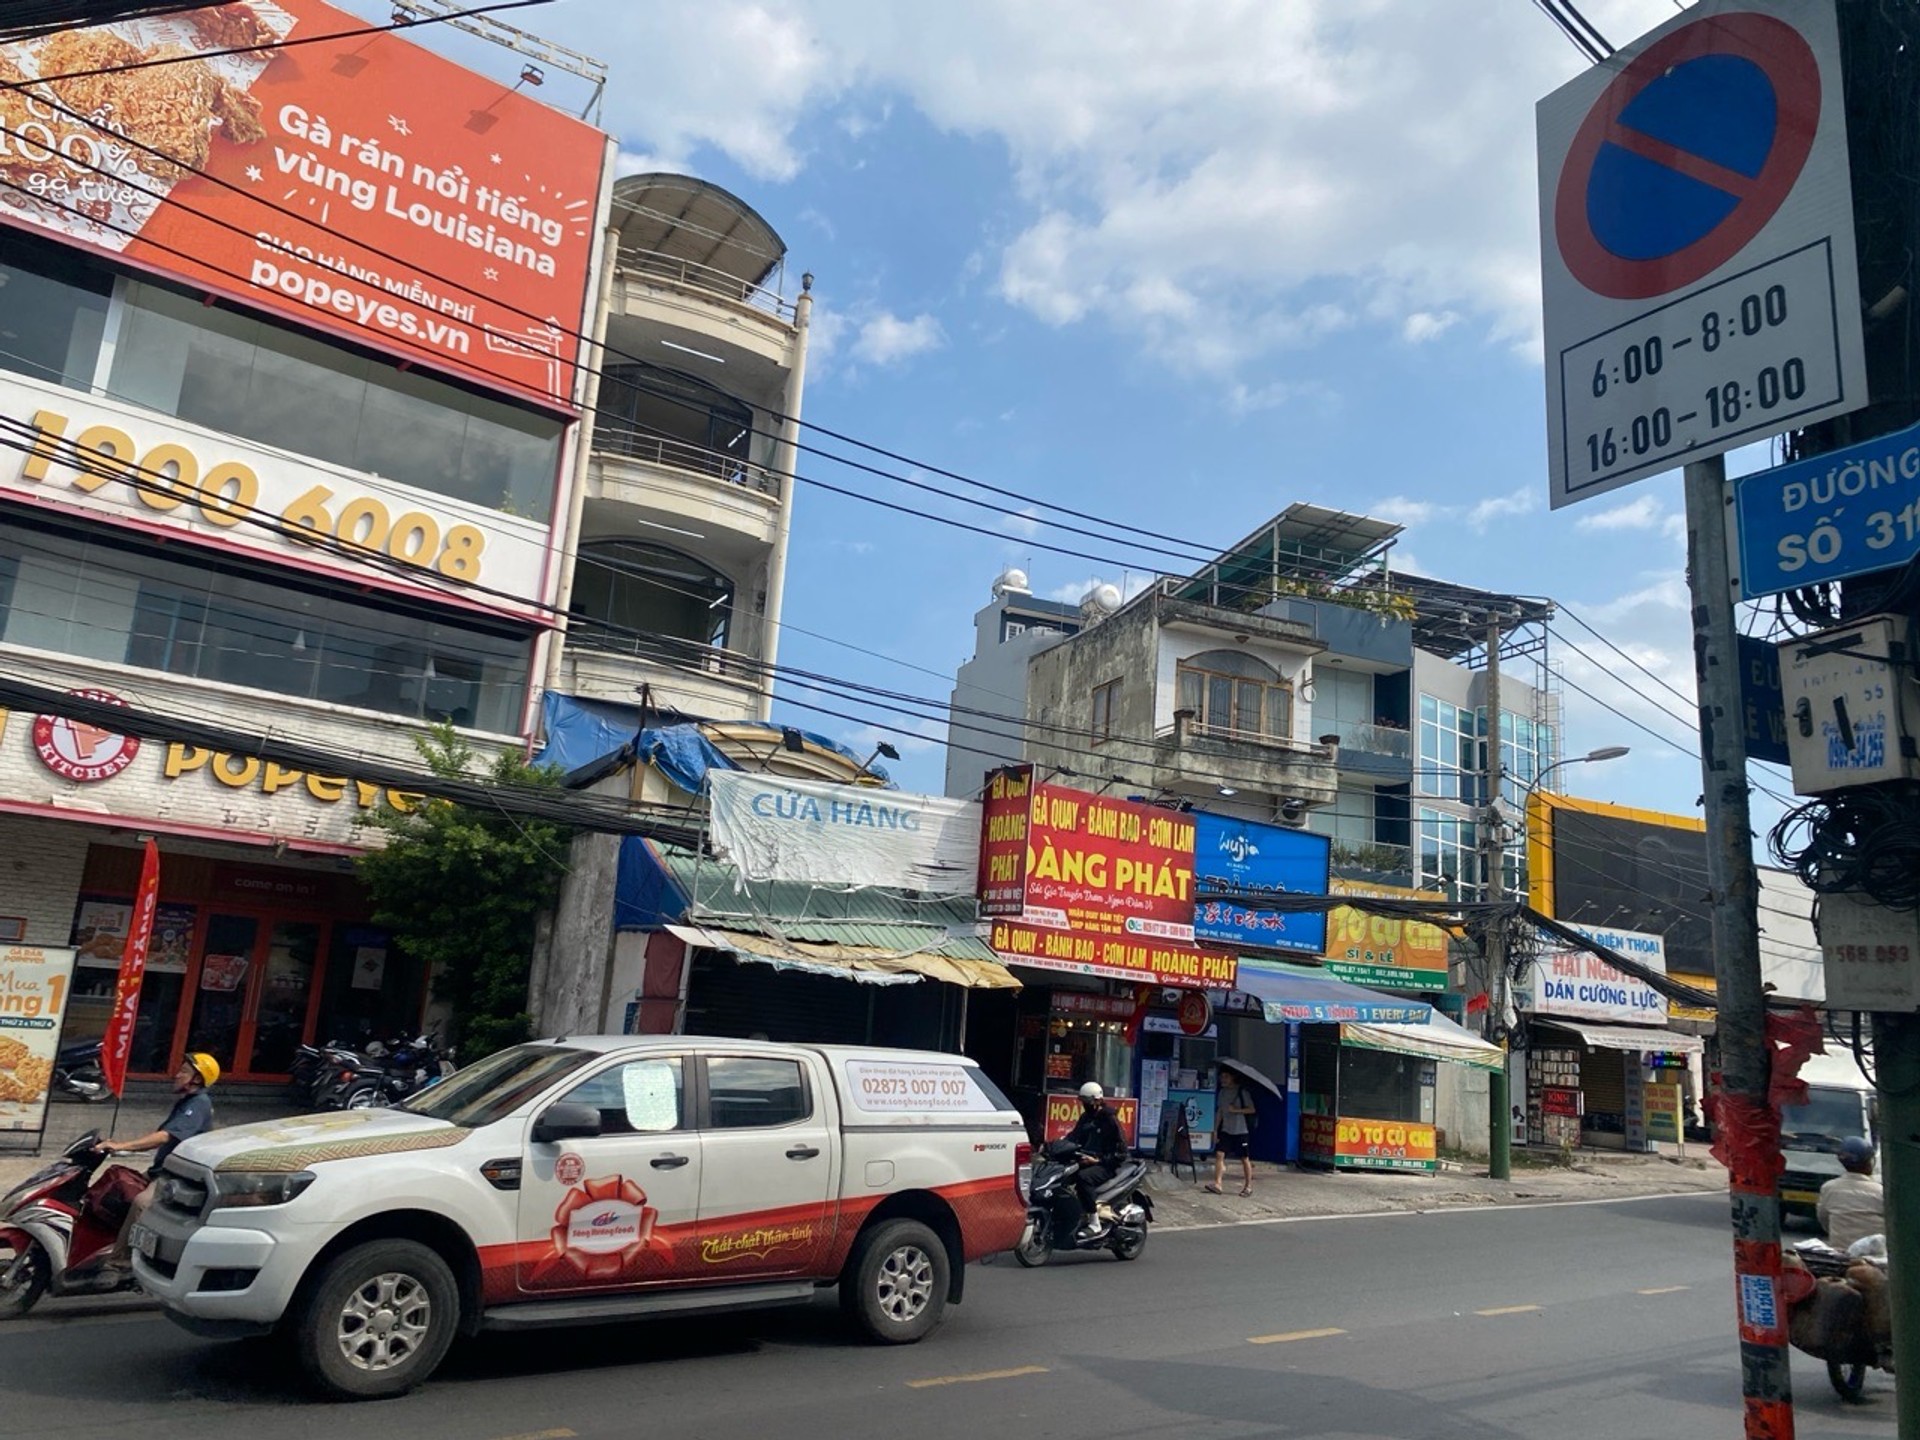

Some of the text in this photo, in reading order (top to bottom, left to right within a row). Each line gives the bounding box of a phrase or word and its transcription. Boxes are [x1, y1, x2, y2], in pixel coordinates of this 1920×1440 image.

[279, 104, 560, 248] Gà rán nổi tiếng
[273, 146, 557, 278] vùng Louisiana
[255, 231, 313, 264] GIAO
[317, 250, 381, 287] HÀNG
[440, 298, 476, 324] PHÍ
[249, 259, 471, 354] popeyes.vn
[22, 410, 486, 581] 1900 6008
[1782, 447, 1920, 513] ĐƯỜNG
[1777, 507, 1844, 572] SỐ
[39, 742, 131, 779] KITCHEN
[751, 788, 821, 822] CỬA
[1033, 790, 1048, 826] GÀ
[1051, 799, 1079, 831] QUAY
[1088, 801, 1118, 839] BÁNH
[1120, 812, 1140, 842] BAO
[1149, 817, 1172, 849] CƠM
[1173, 823, 1195, 854] LAM
[234, 878, 272, 889] come
[275, 883, 294, 893] on
[990, 849, 1019, 881] PHÁT
[1115, 858, 1191, 901] PHÁT
[995, 923, 1008, 950] GÀ
[1012, 930, 1038, 953] QUAY
[1045, 929, 1073, 957] BÁNH
[1075, 940, 1095, 961] BAO
[1103, 942, 1127, 967] CƠM
[1128, 946, 1147, 969] LAM
[1152, 950, 1198, 976] HOÀNG
[1202, 955, 1238, 981] PHÁT
[1626, 937, 1660, 956] THOẠI
[1282, 1005, 1309, 1019] MUA
[1315, 1007, 1323, 1018] 5
[1361, 1008, 1367, 1019] 1
[1372, 1008, 1405, 1020] EVERY
[1409, 1010, 1428, 1020] DAY
[1545, 979, 1658, 1010] DÁN CƯỜNG LỰC
[116, 991, 138, 1058] MUA
[863, 1078, 966, 1096] 02873 007 007
[1338, 1122, 1434, 1149] BÒ TƠ CỦ CHI
